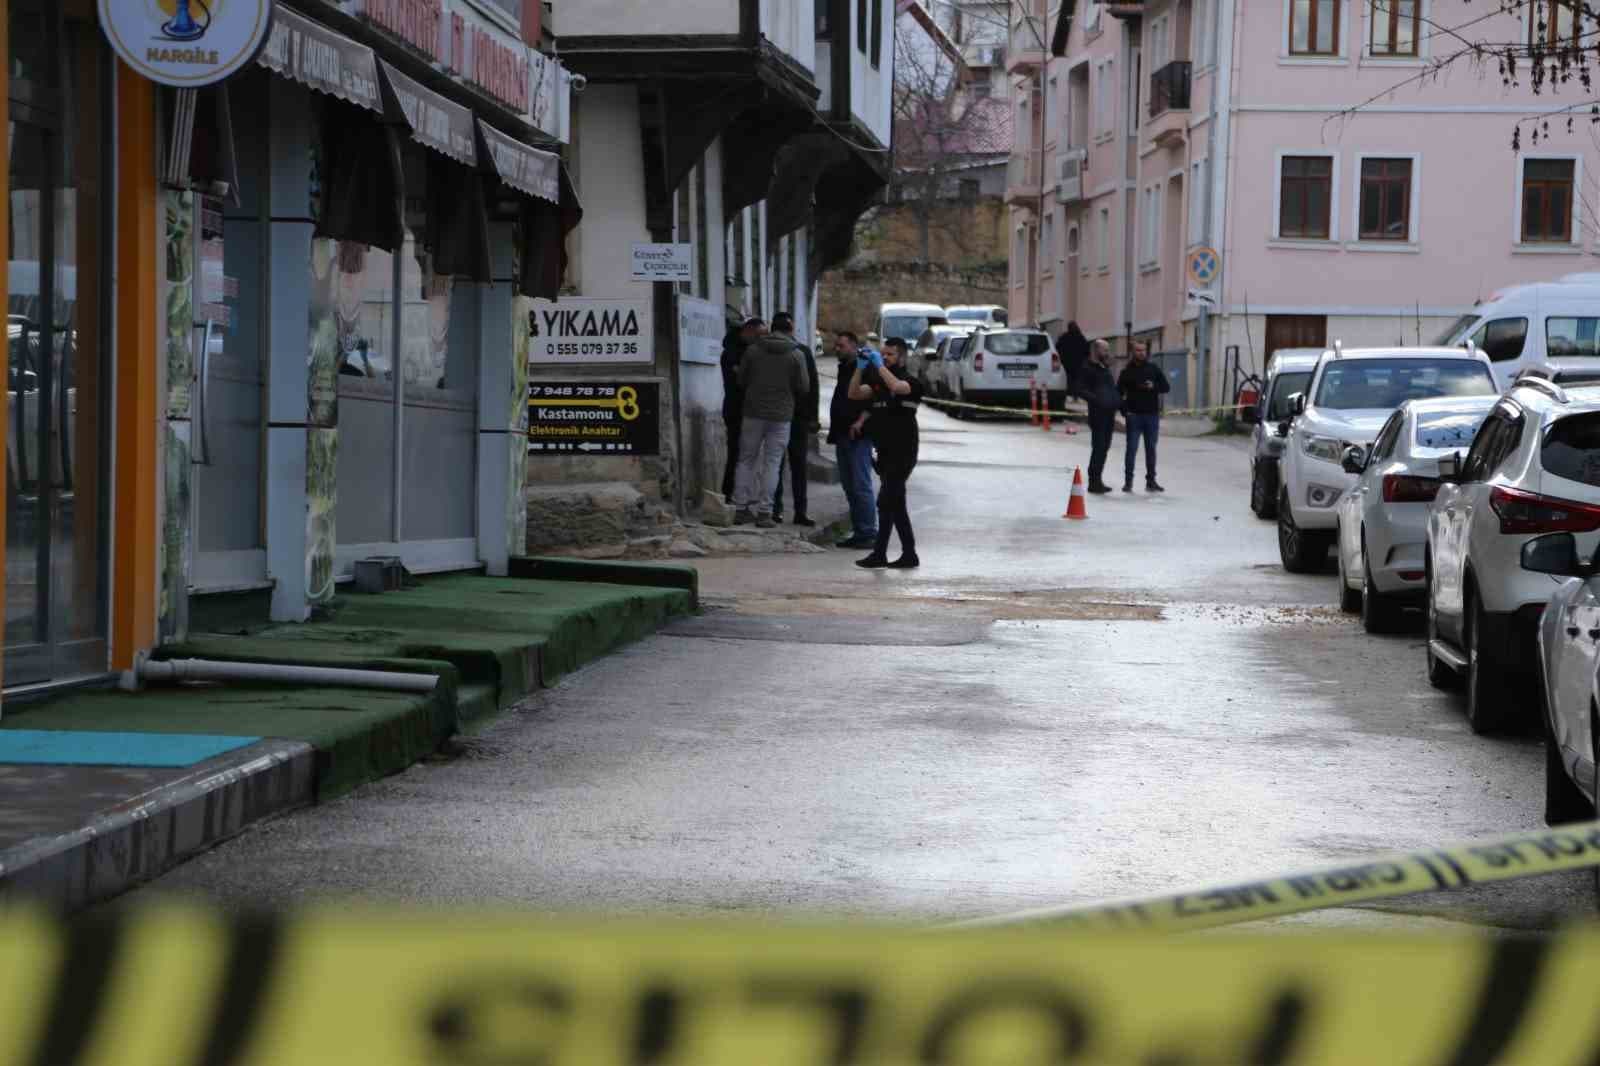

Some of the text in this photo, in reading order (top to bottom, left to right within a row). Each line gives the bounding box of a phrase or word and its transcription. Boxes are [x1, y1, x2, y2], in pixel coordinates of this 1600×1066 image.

[146, 46, 219, 65] HARGİLE
[543, 309, 640, 336] YIKAMA
[546, 342, 638, 355] 0 555 079 37 36
[543, 387, 572, 396] 948
[576, 387, 594, 396] 78
[598, 387, 615, 396] 78
[538, 408, 614, 420] Kastamonu
[530, 426, 579, 436] Elektronik
